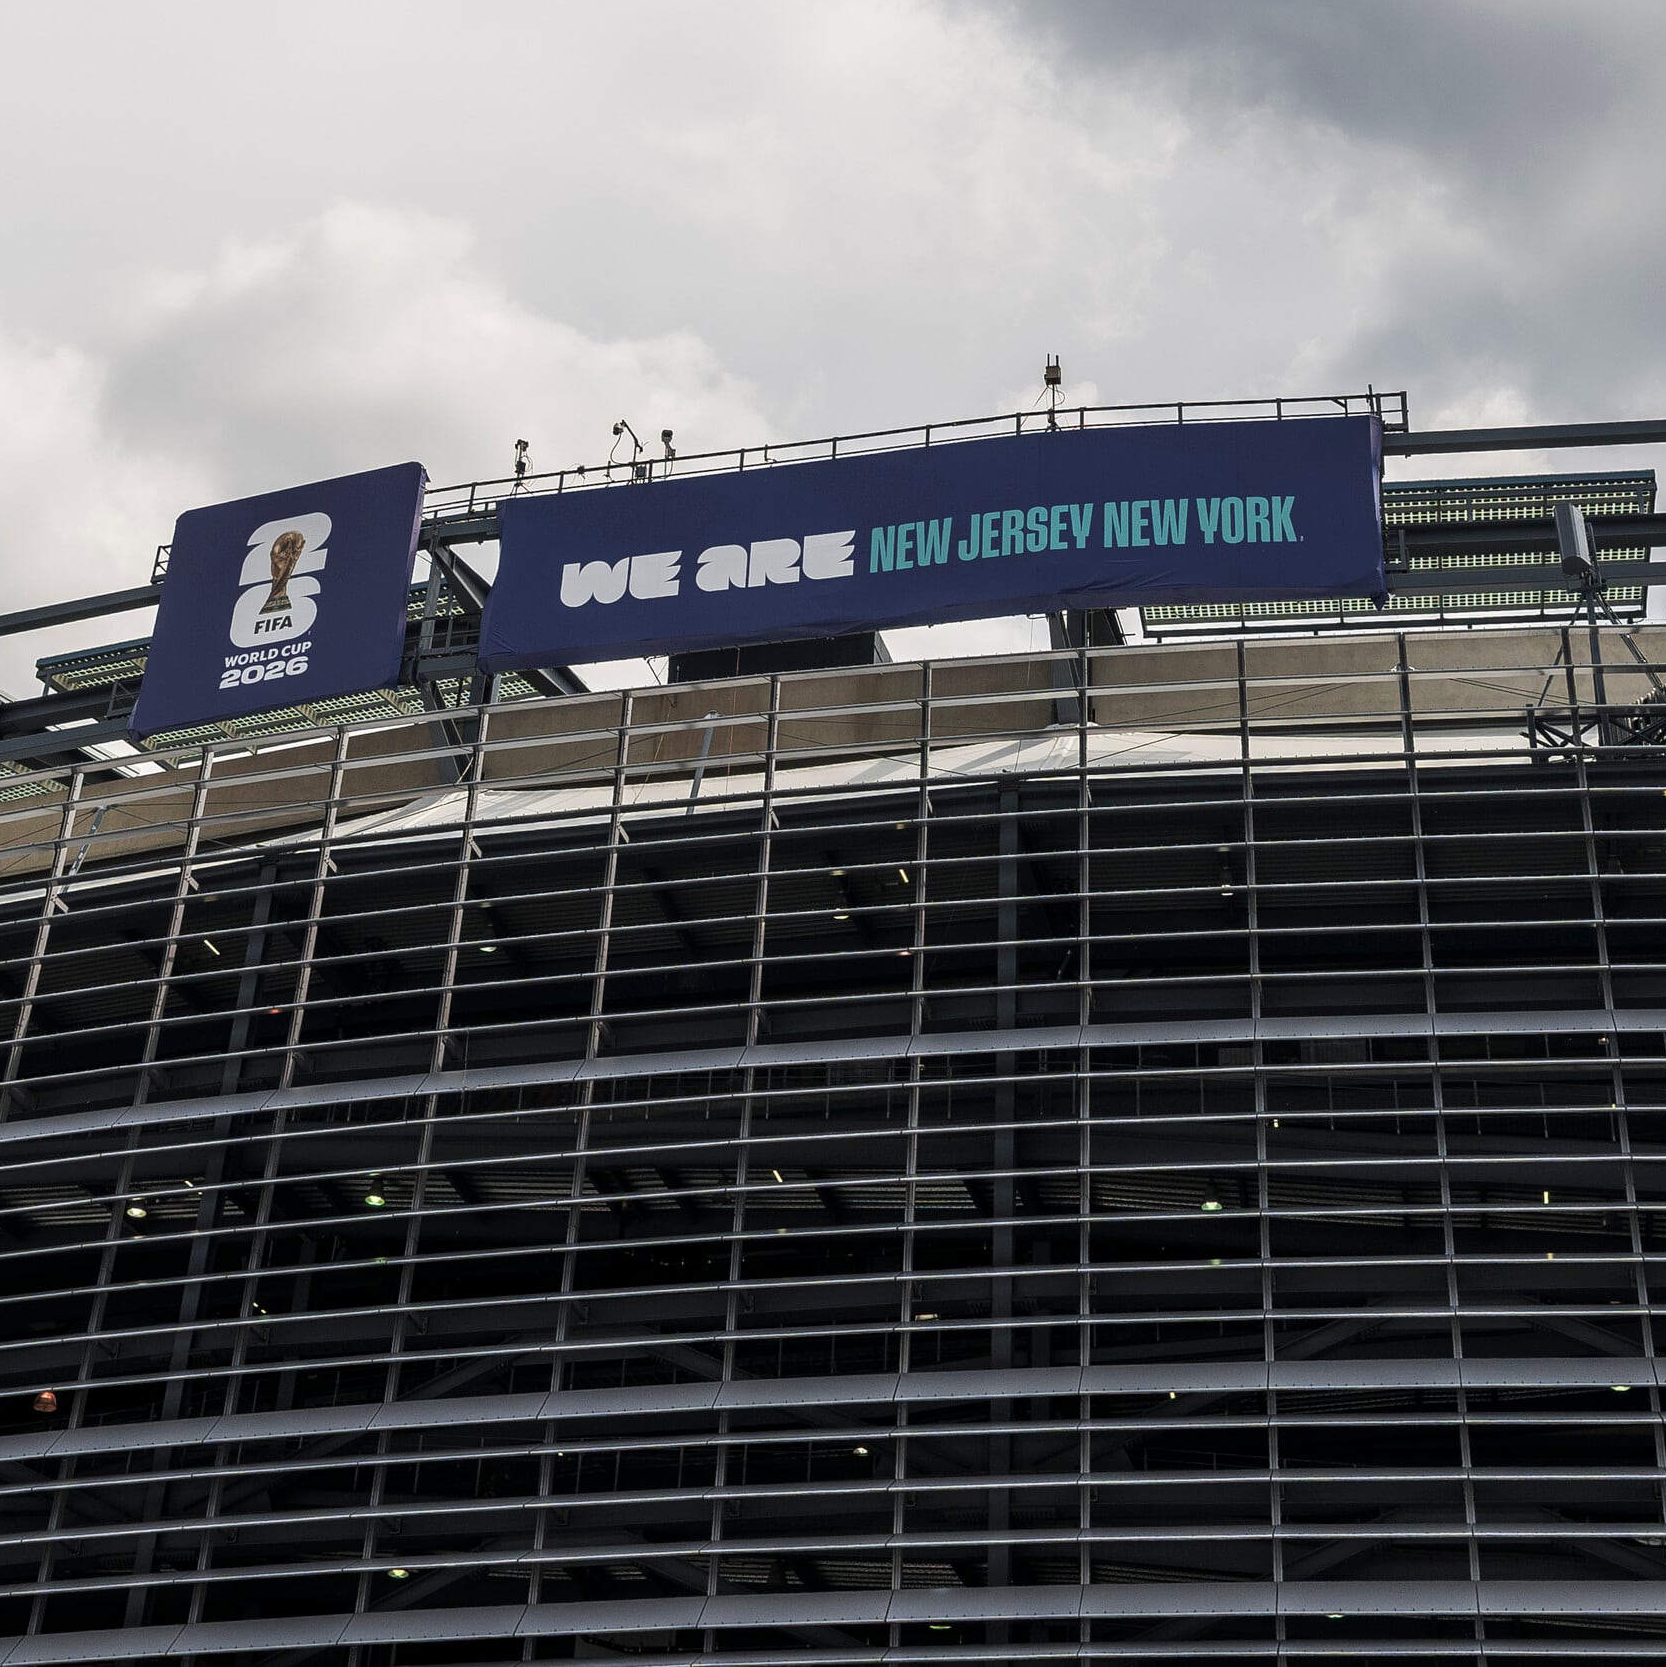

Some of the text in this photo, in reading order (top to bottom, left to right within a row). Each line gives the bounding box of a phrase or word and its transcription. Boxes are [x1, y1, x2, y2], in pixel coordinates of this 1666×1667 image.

[560, 496, 1296, 607] WE ARE NEW JERSEY NEW YORK
[254, 616, 293, 635] FIFA
[225, 641, 312, 668] WORLD CUP
[219, 656, 309, 690] 2026
